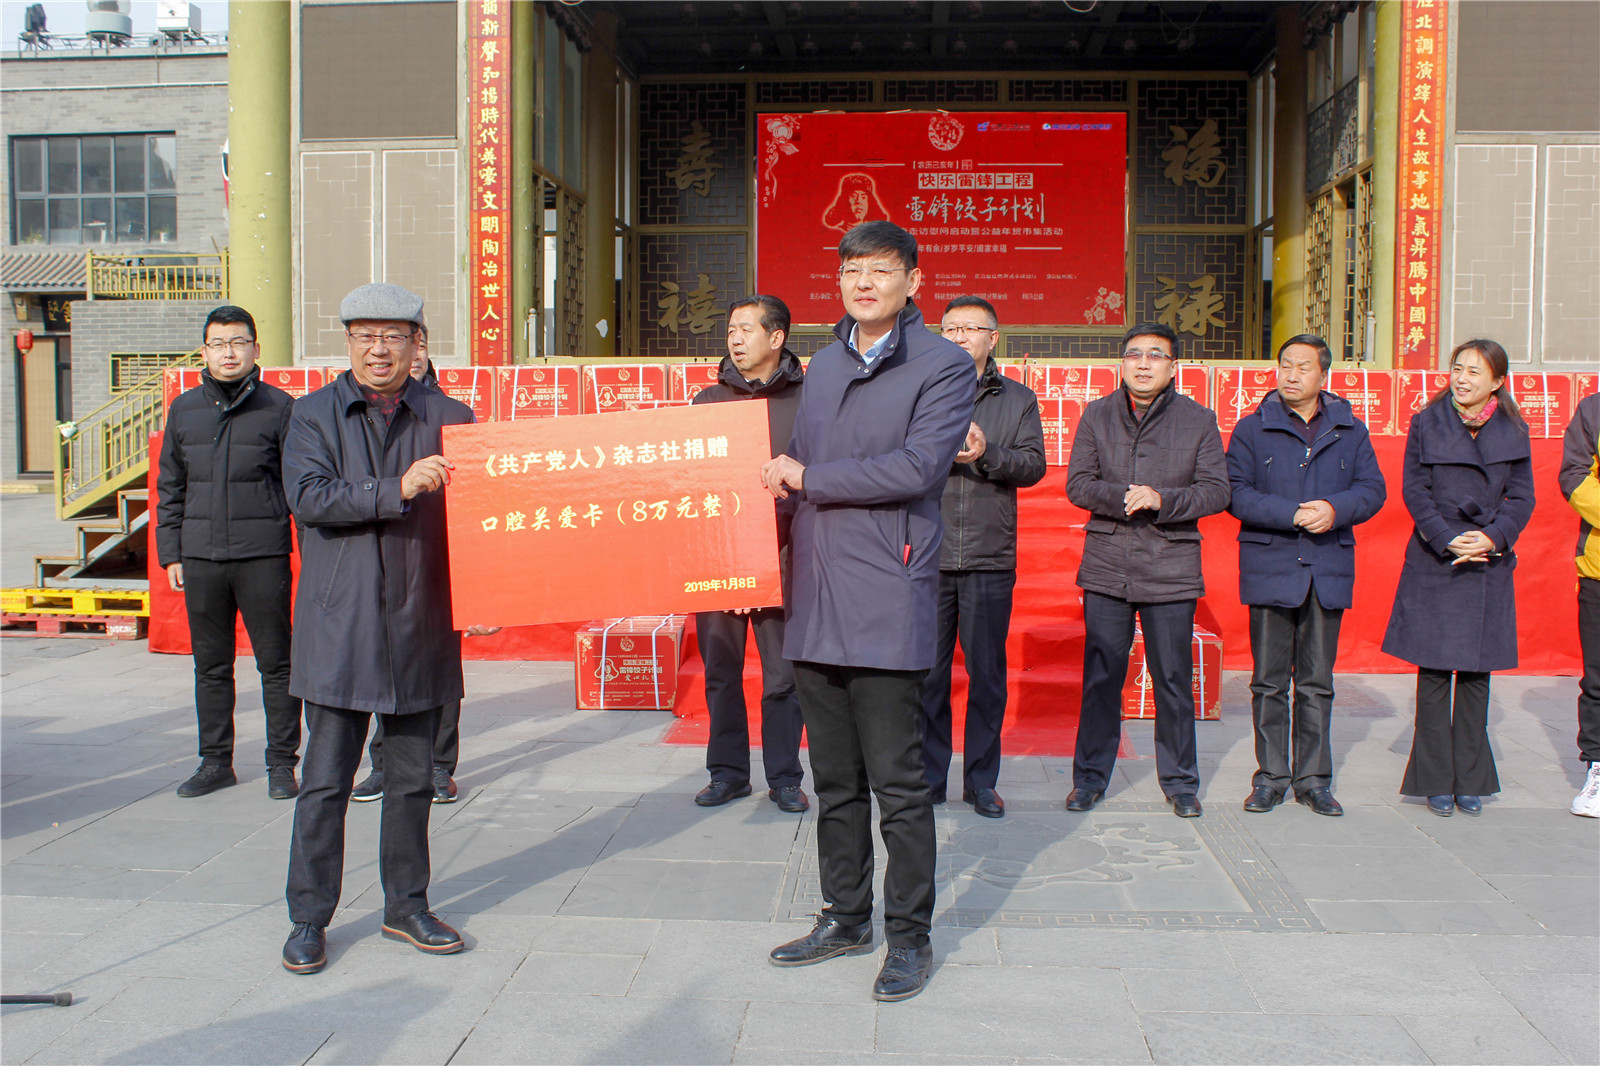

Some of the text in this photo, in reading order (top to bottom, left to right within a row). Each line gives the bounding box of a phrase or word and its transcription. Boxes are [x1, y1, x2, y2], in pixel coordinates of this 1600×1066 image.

[919, 174, 1032, 188] 快乐雷锋工程
[906, 193, 1045, 224] 雷锋饺子计划
[903, 227, 1064, 236] 走访慰问启动暨公益年货市集活动
[484, 435, 729, 477] 《共产党人》杂志社捐赠
[481, 490, 741, 532] 口腔关爱卡（8万元整）
[684, 576, 757, 593] 2019年1月8日
